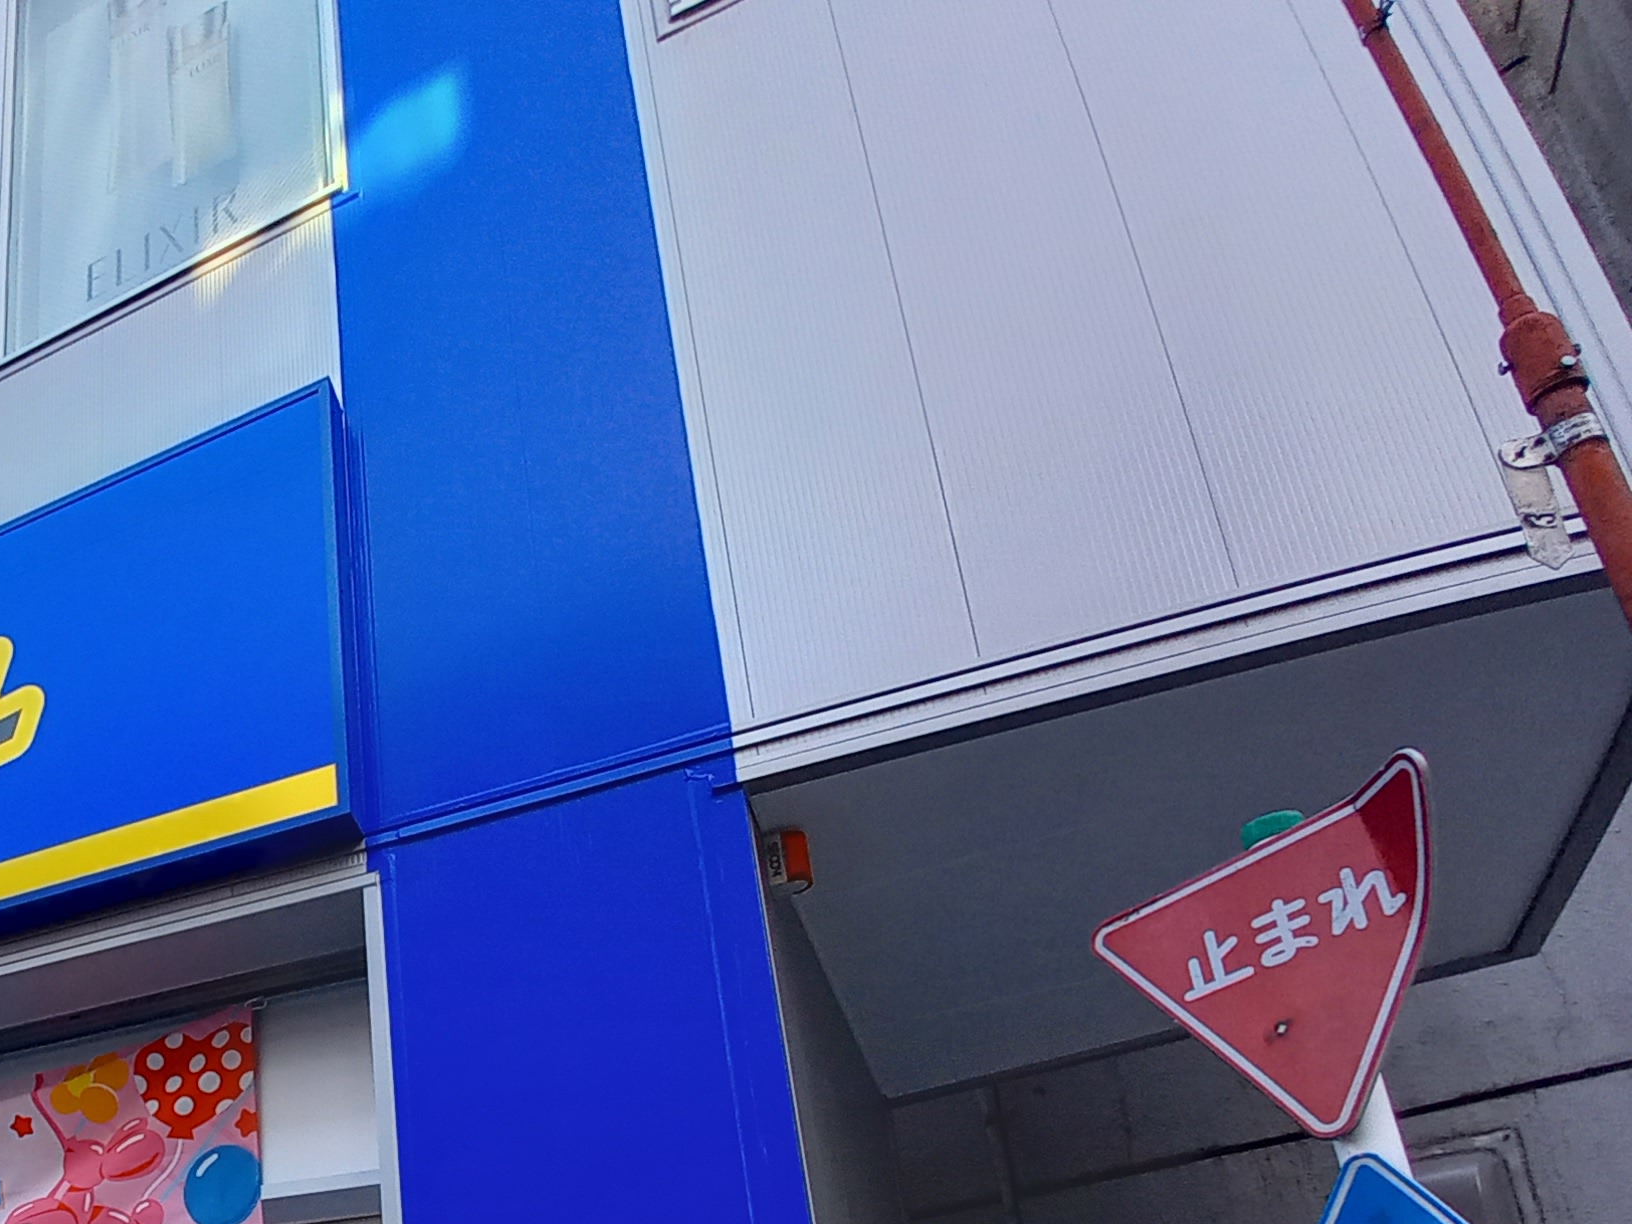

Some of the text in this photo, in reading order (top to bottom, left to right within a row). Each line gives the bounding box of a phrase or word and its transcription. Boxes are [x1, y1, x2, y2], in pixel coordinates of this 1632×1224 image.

[86, 192, 239, 302] ELIXIR
[1183, 867, 1407, 1001] 止まれ
